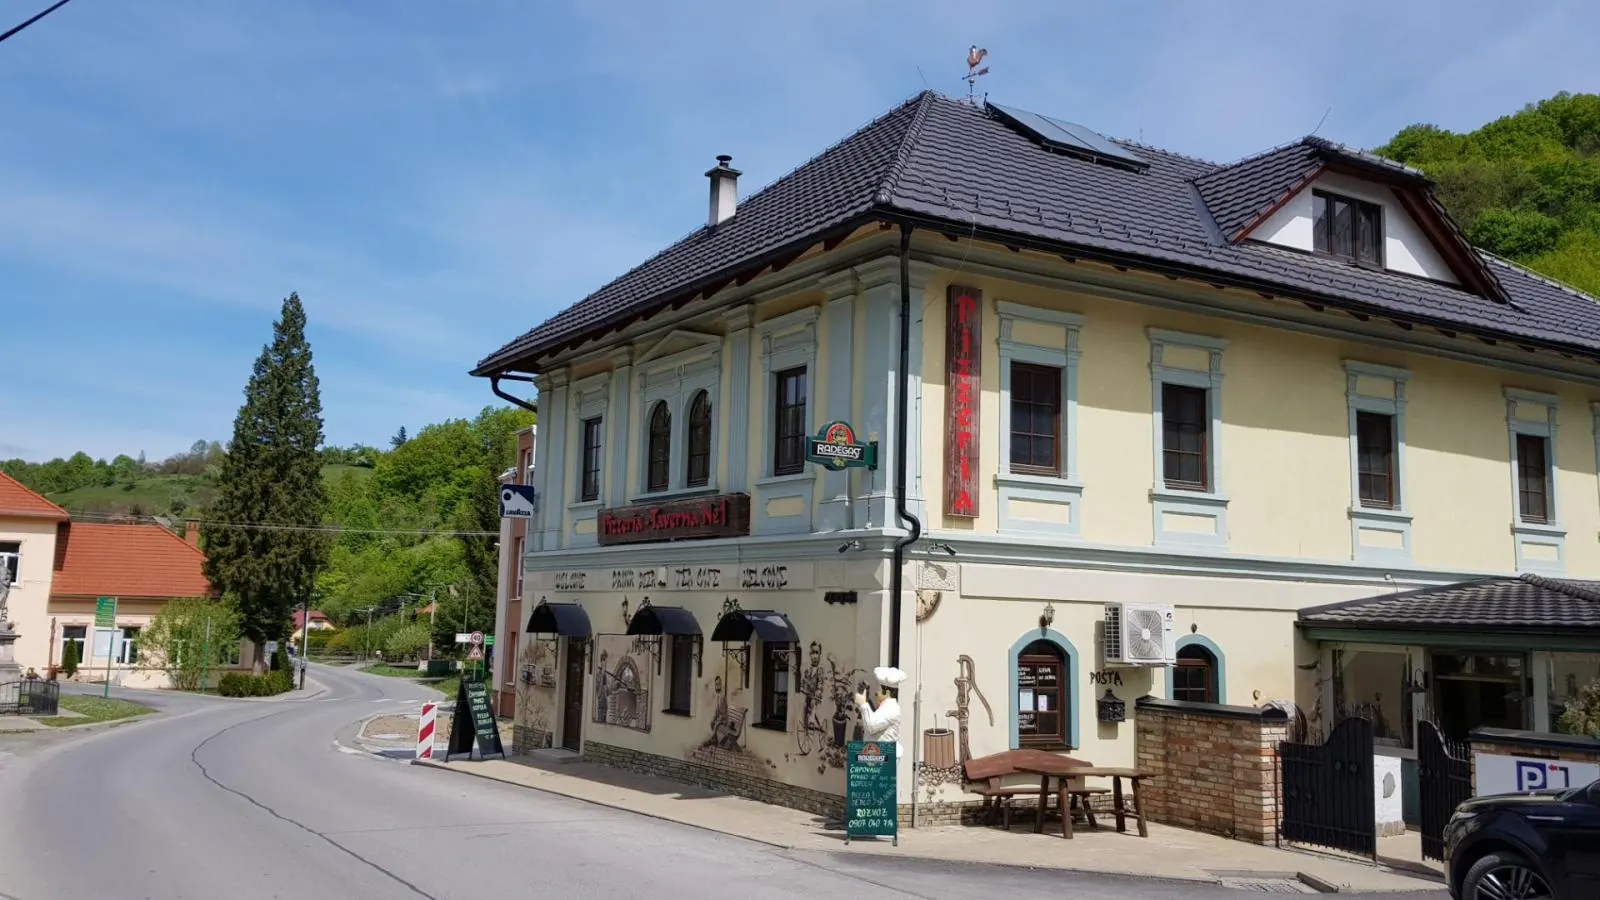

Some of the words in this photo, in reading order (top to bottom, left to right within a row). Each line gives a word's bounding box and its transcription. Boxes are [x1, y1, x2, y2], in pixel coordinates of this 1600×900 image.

[817, 444, 862, 459] RADEGAST
[653, 507, 697, 530] Taverna
[1089, 669, 1123, 686] POŠTA
[1521, 766, 1543, 791] P
